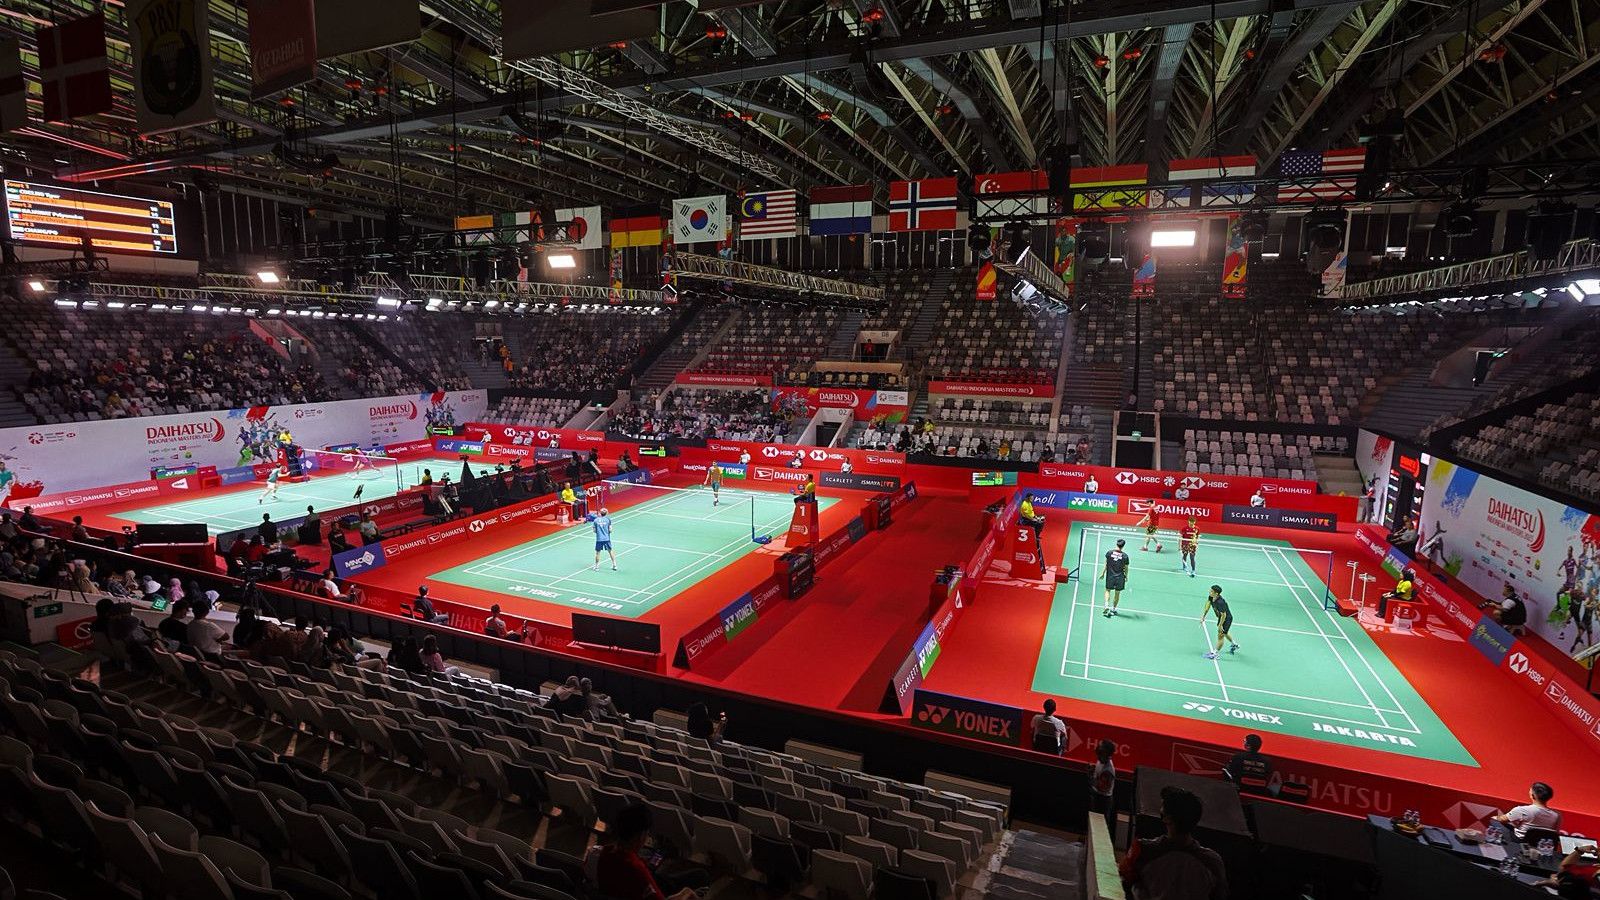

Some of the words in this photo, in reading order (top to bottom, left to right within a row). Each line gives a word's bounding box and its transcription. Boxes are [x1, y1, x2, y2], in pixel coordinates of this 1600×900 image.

[819, 392, 853, 401] DAIHATSU
[369, 403, 411, 417] DAIHATSU
[146, 422, 212, 440] DAIHATSU
[148, 437, 177, 445] INDONESIA
[468, 444, 482, 452] YONEX
[502, 447, 530, 457] DAIHATSU
[726, 467, 745, 475] YONEX
[1057, 470, 1085, 478] DAIHATSU
[1140, 476, 1161, 484] HSBC
[1207, 481, 1229, 489] HSBC
[82, 492, 113, 502] DAIHATSU
[1278, 486, 1312, 495] DAIHATSU
[31, 499, 64, 509] DAIHATSU
[1088, 498, 1114, 508] YONEX
[800, 505, 806, 517] 1
[1157, 503, 1210, 517] DAIHATSU
[1231, 512, 1270, 520] SCARLETT
[1488, 497, 1537, 533] DAIHATSU
[485, 517, 499, 526] HSBC
[441, 526, 466, 539] DAIHATSU
[1018, 529, 1029, 542] 3
[399, 538, 427, 552] DAIHATSU
[528, 587, 562, 599] YONEX
[570, 596, 624, 611] JAKARTA
[735, 602, 755, 623] YONEX
[699, 625, 724, 649] DAIHATSU
[924, 632, 938, 658] YONEX
[898, 663, 919, 698] SCARLETT
[1527, 667, 1546, 686] HSBC
[1560, 694, 1595, 726] DAIHATSU
[954, 709, 1012, 739] YONEX
[1219, 705, 1284, 726] YONEX
[1312, 721, 1417, 748] JAKARTA
